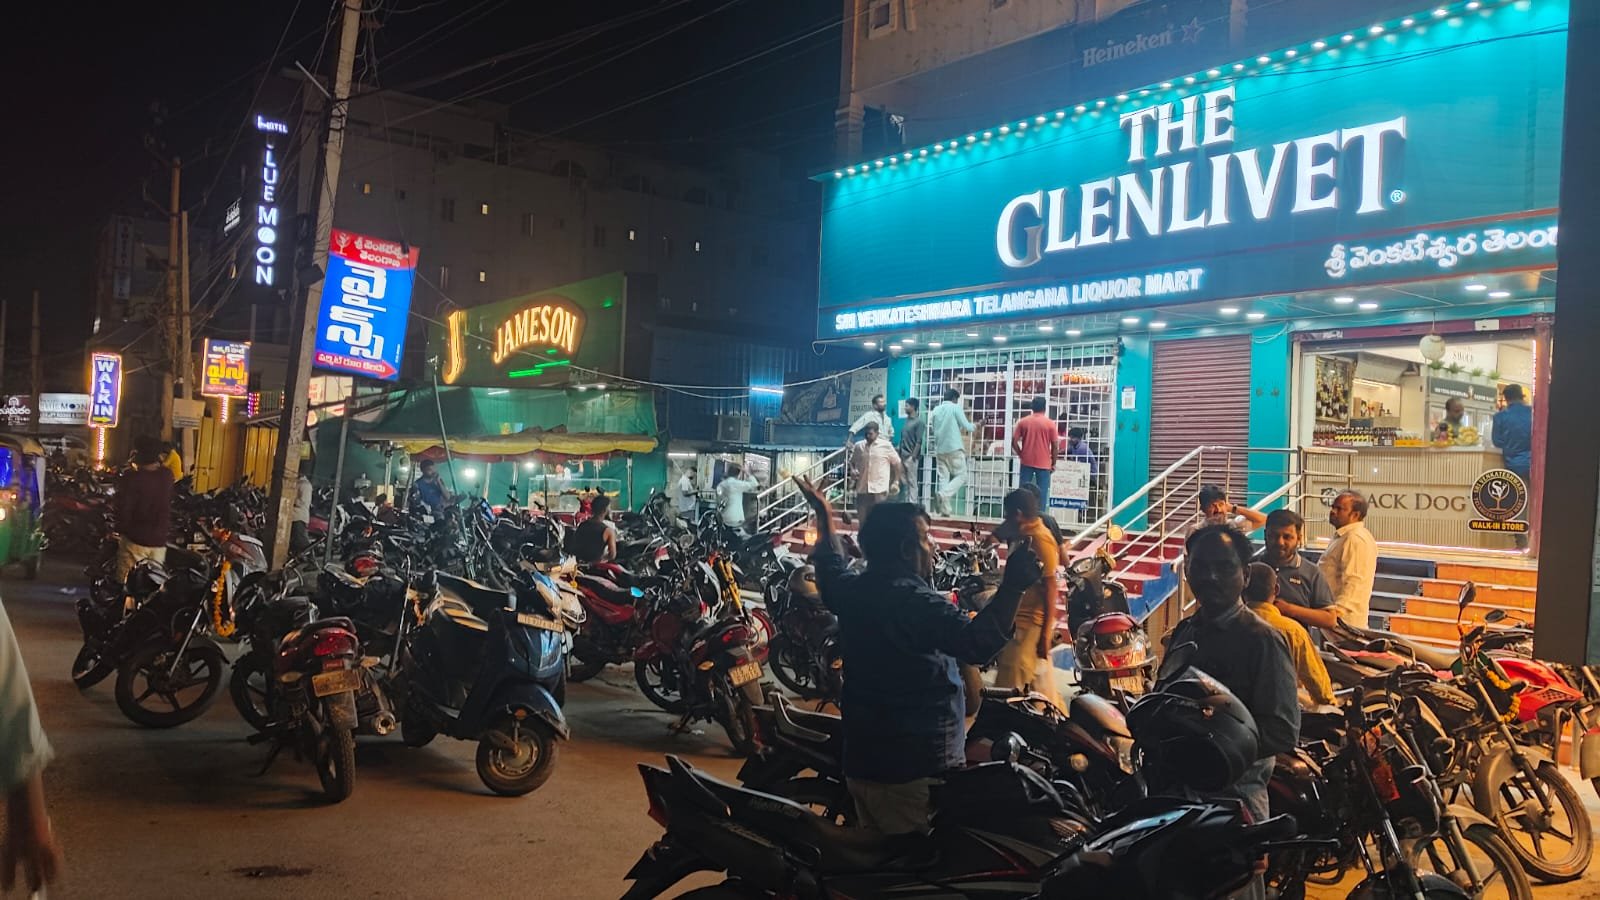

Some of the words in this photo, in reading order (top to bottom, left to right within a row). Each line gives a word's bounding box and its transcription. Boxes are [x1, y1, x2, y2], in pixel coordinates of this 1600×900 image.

[1083, 30, 1172, 68] Heineken
[1119, 86, 1236, 162] THE
[263, 143, 278, 202] LUE
[996, 116, 1407, 269] GLENLIVET
[1324, 244, 1347, 278] శ్రీ
[836, 312, 858, 330] SRI
[857, 298, 972, 329] VENKATESHWARA
[973, 286, 1068, 316] TELANGANA
[1072, 276, 1141, 304] LIQUOR
[1145, 268, 1204, 296] MART
[493, 304, 577, 365] JAMESON
[96, 361, 114, 404] WALK
[94, 405, 114, 416] IN
[1367, 493, 1408, 510] ACK
[1415, 492, 1467, 512] DOG
[1471, 521, 1501, 530] WALK-IN
[1501, 523, 1525, 531] STORE
